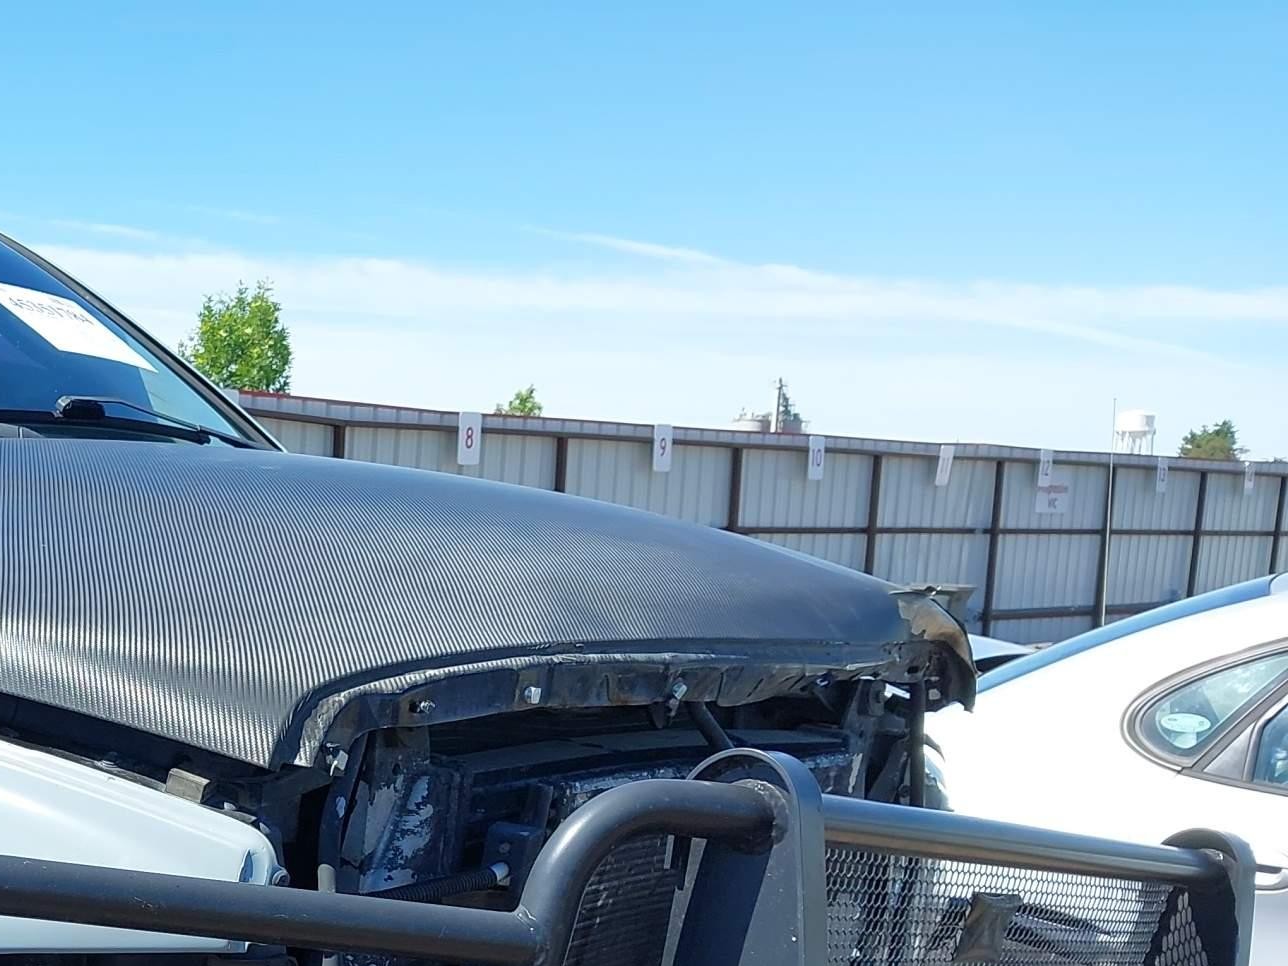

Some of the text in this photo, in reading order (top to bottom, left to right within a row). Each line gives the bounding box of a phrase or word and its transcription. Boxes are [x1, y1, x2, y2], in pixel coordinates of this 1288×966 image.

[465, 426, 474, 449] 8
[659, 437, 667, 456] 9
[811, 448, 822, 467] 10
